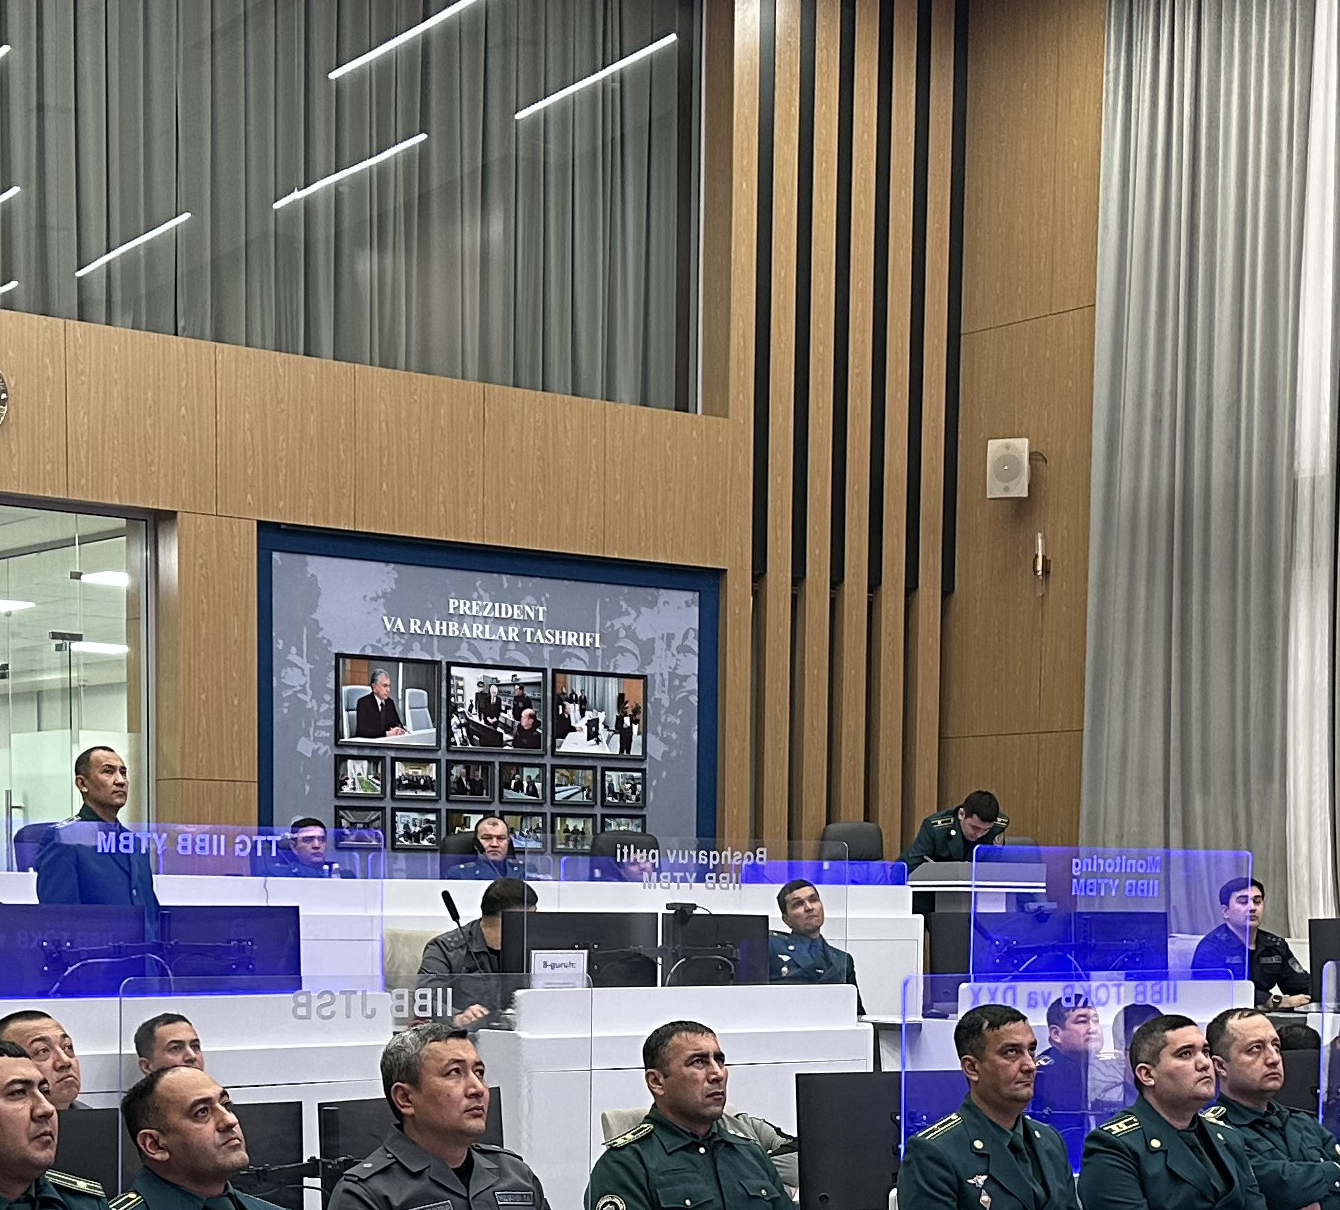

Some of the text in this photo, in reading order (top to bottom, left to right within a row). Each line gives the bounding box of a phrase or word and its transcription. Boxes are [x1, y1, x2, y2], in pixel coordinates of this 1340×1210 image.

[448, 598, 547, 622] PREZIDENT
[382, 615, 601, 648] VA RAHBARLAR TASHRIFI
